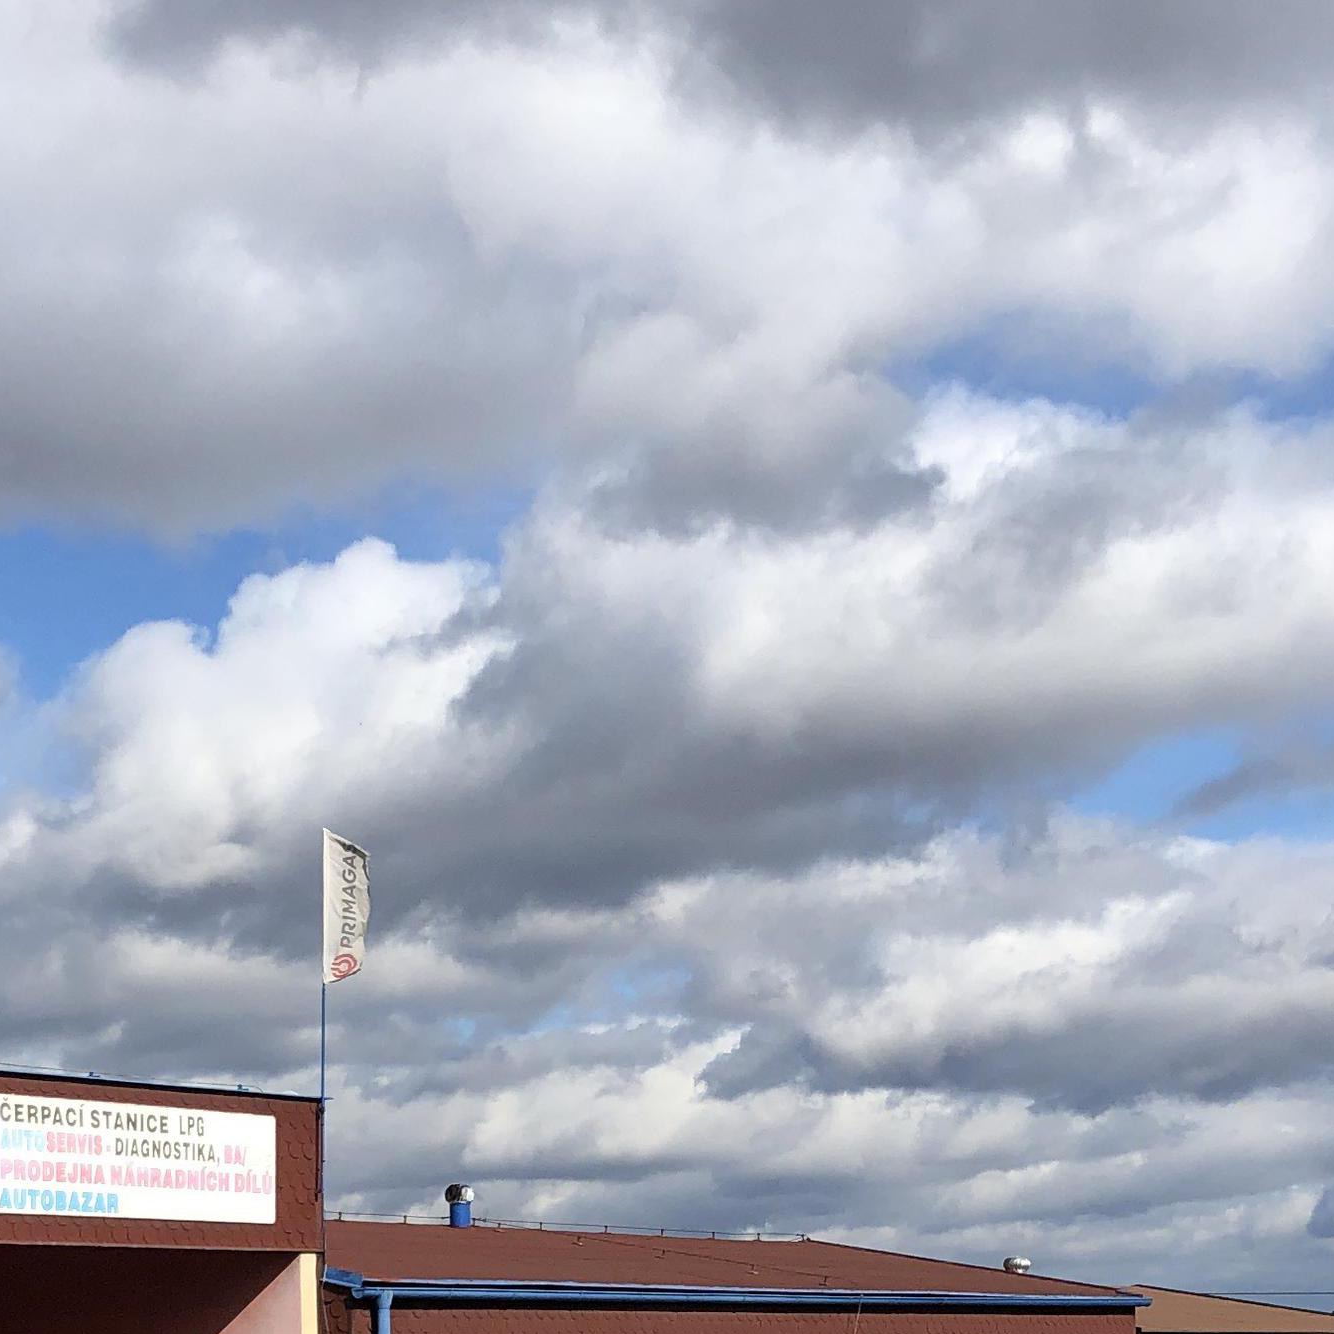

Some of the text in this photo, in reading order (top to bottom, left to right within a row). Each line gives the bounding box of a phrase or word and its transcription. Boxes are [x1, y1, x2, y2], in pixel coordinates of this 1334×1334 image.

[0, 1097, 205, 1137] ČERPACÍ STANICE LPG
[0, 1127, 103, 1156] AUTOSERVIS
[115, 1137, 220, 1166] DIAGNOSTIKA,
[0, 1158, 105, 1185] PRODEJNA
[111, 1161, 230, 1192] NÁHRADNÍCH
[0, 1187, 119, 1214] AUTOBAZAR
